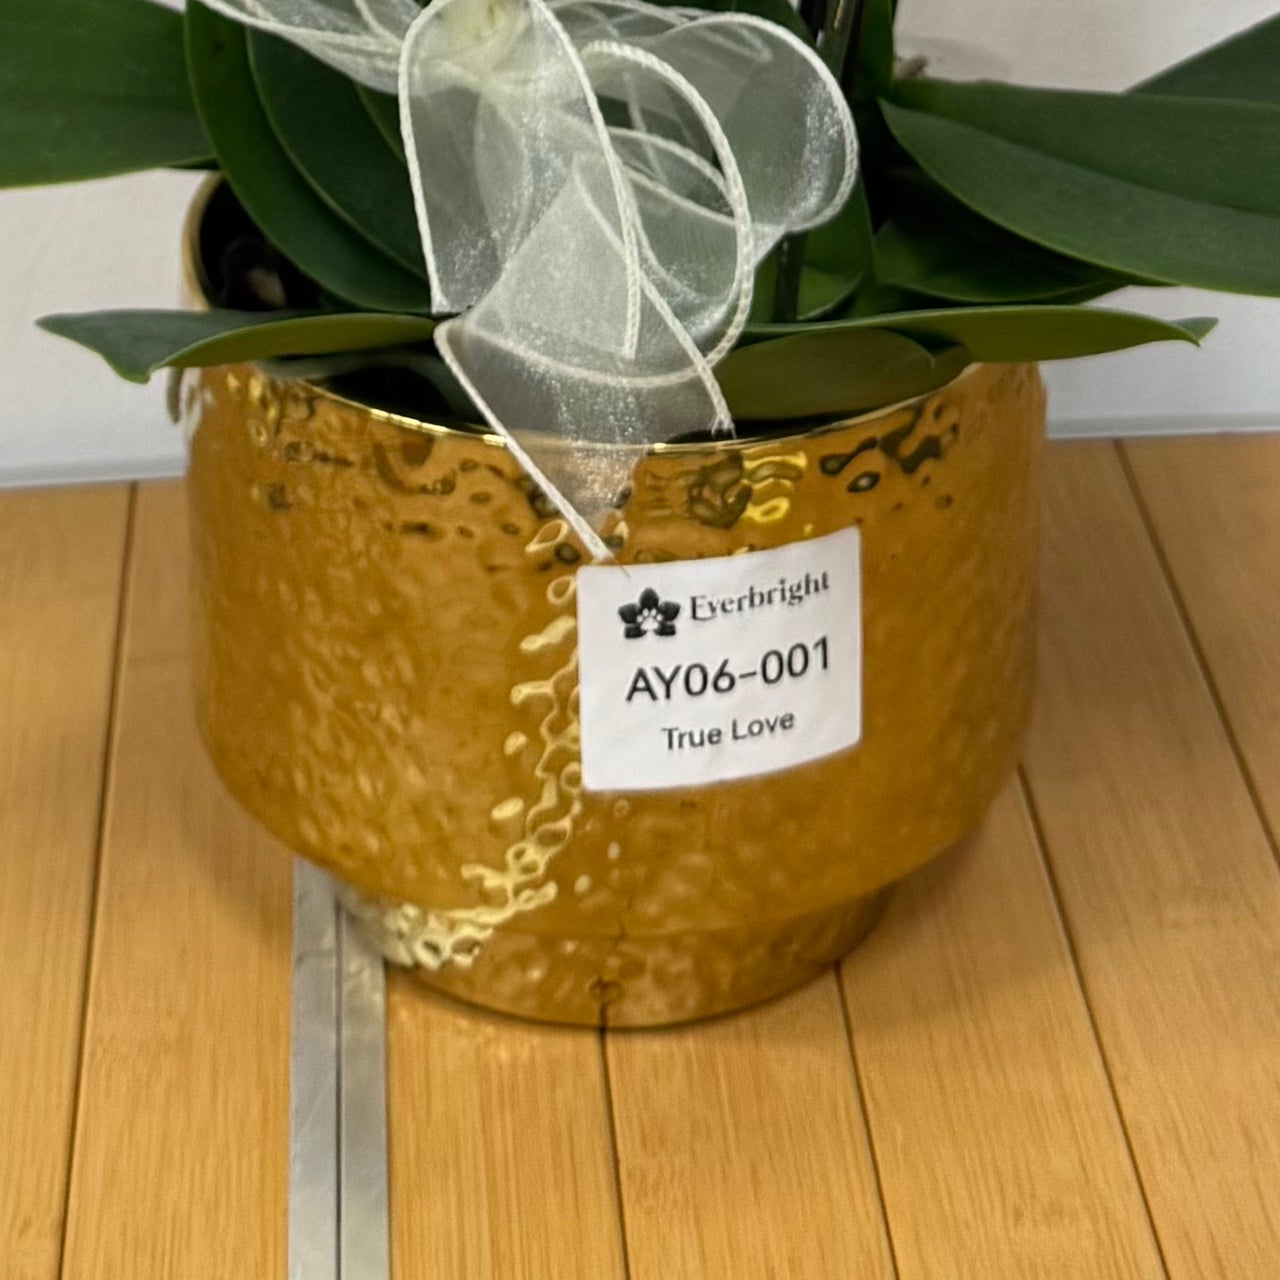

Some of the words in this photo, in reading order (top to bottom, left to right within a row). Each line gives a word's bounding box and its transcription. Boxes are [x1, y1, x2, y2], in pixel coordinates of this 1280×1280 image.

[690, 570, 830, 622] Everbright
[625, 636, 829, 703] AY06-001
[662, 726, 722, 751] True
[731, 711, 795, 741] Love
